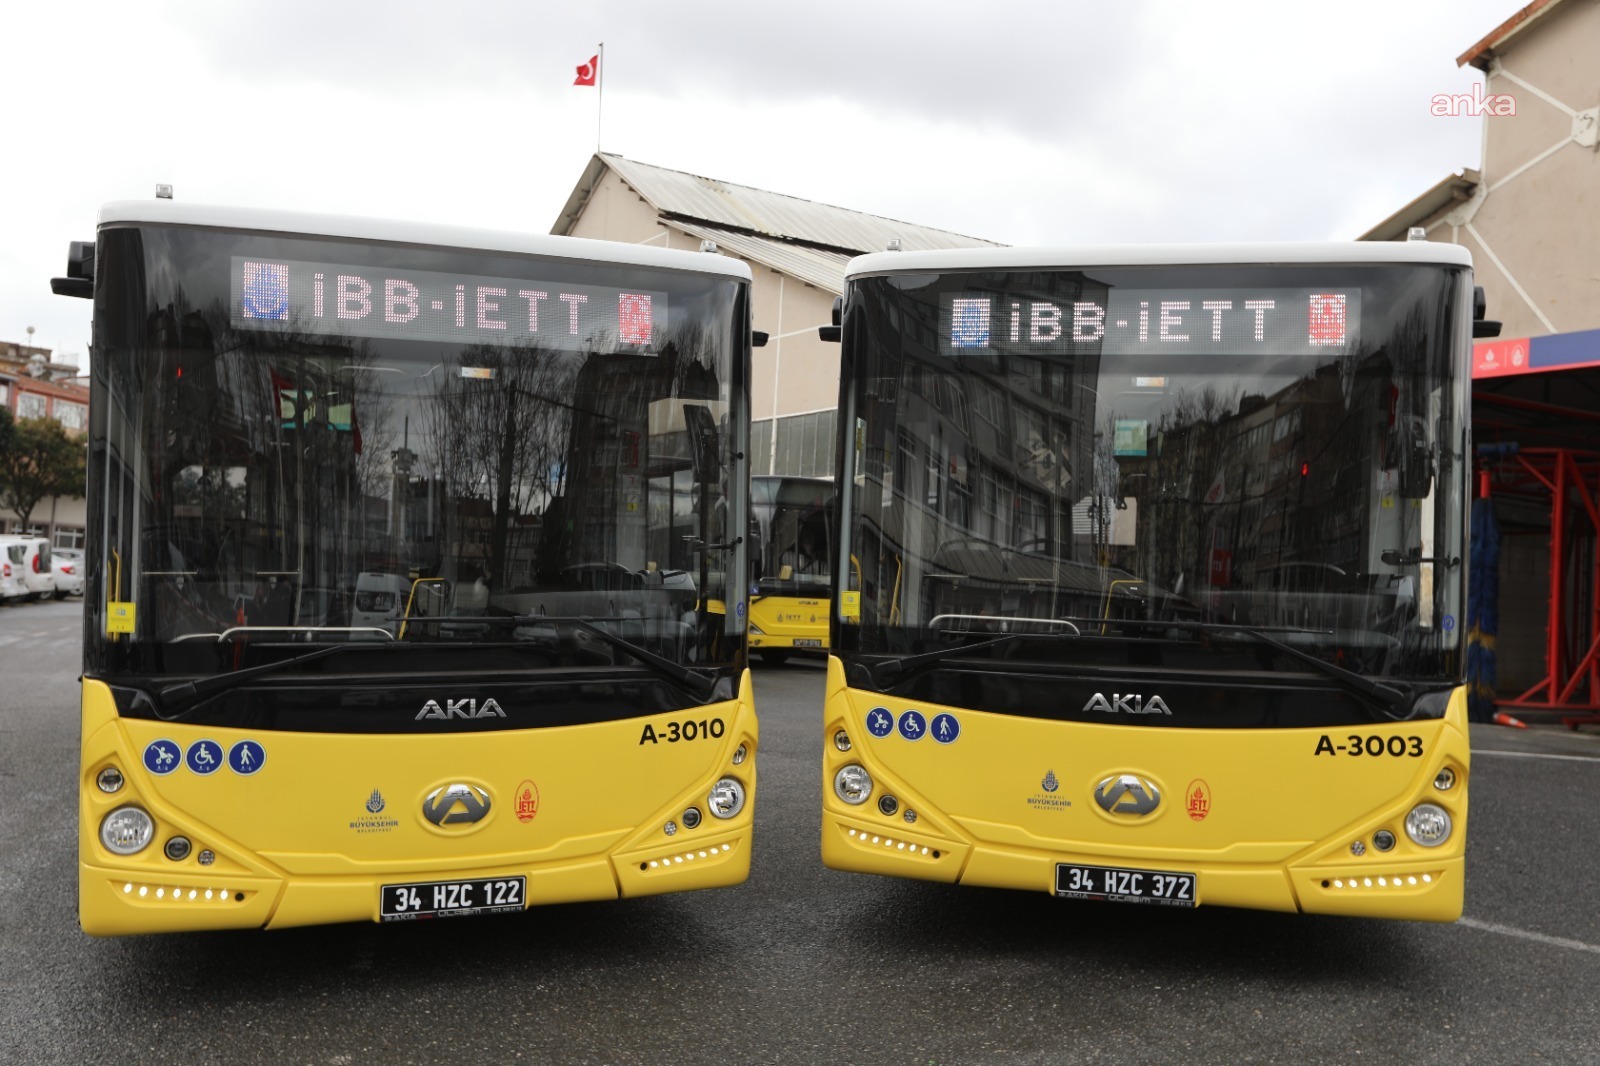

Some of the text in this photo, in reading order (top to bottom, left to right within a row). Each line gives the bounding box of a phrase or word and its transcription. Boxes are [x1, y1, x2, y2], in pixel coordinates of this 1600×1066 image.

[415, 697, 507, 720] AKIA
[1082, 692, 1173, 716] AKIA
[639, 718, 725, 746] A-3010
[1314, 735, 1424, 758] A-3003
[395, 880, 520, 912] 34 HZC 122
[1069, 868, 1190, 899] 34 HZC 372
